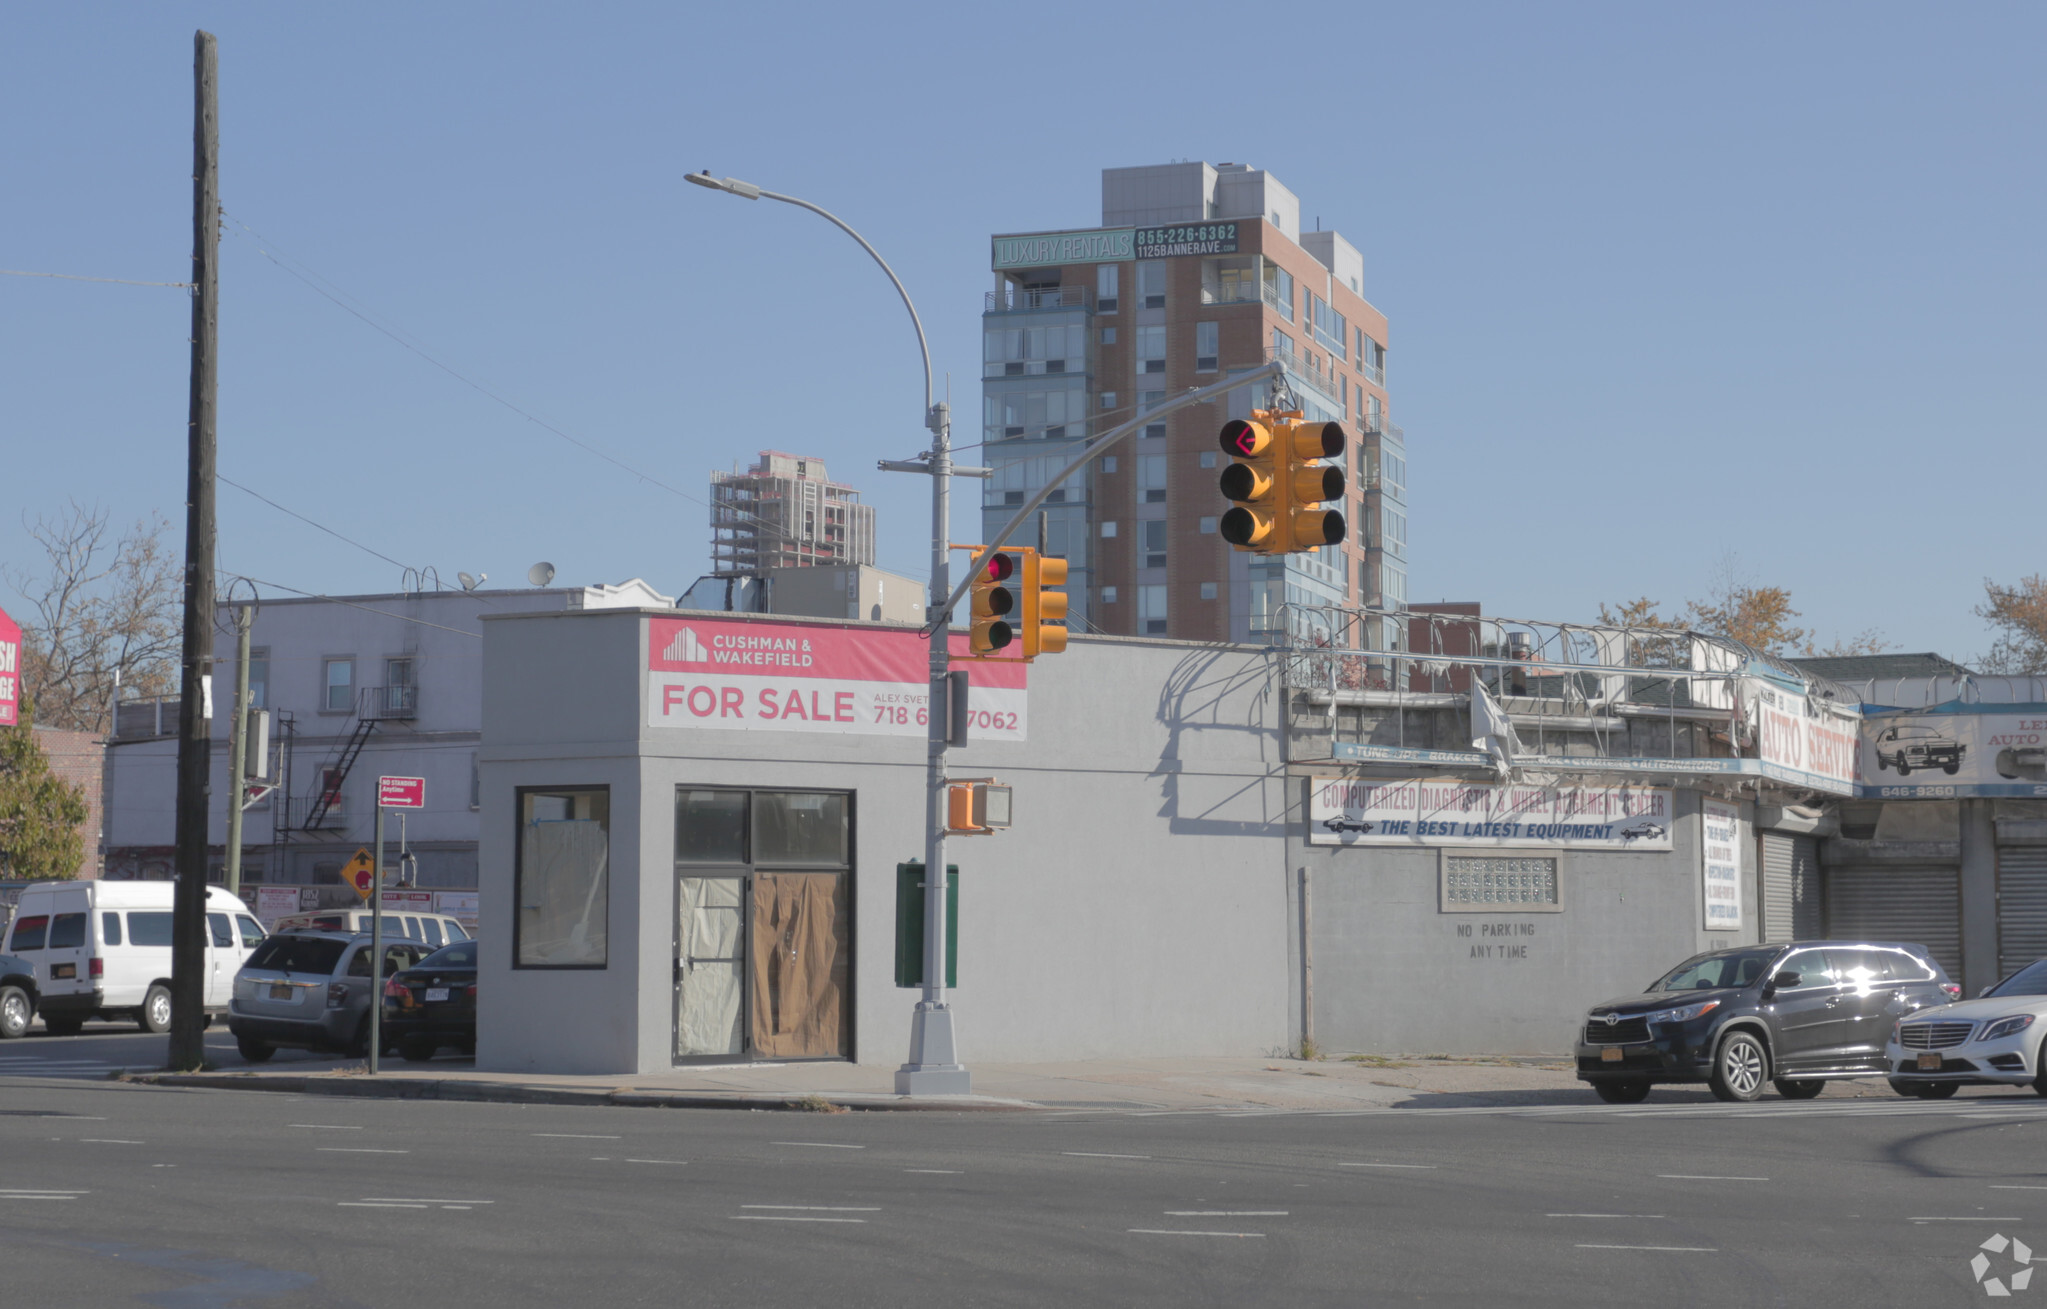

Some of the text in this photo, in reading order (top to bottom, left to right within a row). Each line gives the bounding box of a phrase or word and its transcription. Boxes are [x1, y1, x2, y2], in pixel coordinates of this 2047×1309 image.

[1001, 234, 1131, 264] LUXURY RENTALS
[713, 635, 812, 652] CUSHMAN &
[0, 640, 17, 673] SH
[713, 651, 813, 667] WAKEFIELD
[0, 676, 14, 701] GE
[663, 684, 855, 722] FOR SALE
[874, 693, 929, 705] ALEX SVET
[874, 706, 908, 725] 718
[967, 710, 1018, 730] 7062
[1762, 708, 1862, 780] AUTO SERVICE
[1987, 734, 2041, 746] AUTO
[1640, 760, 1720, 771] ALTERNATORS
[1323, 784, 1665, 817] COMPUTERIZED DIAGNOSTIC & WHEEL ALIGNMENT CENTER
[1380, 820, 1614, 839] THE BEST LATEST EQUIPMENT
[1457, 923, 1535, 937] NO PARKING
[1470, 945, 1528, 959] ANY TIME
